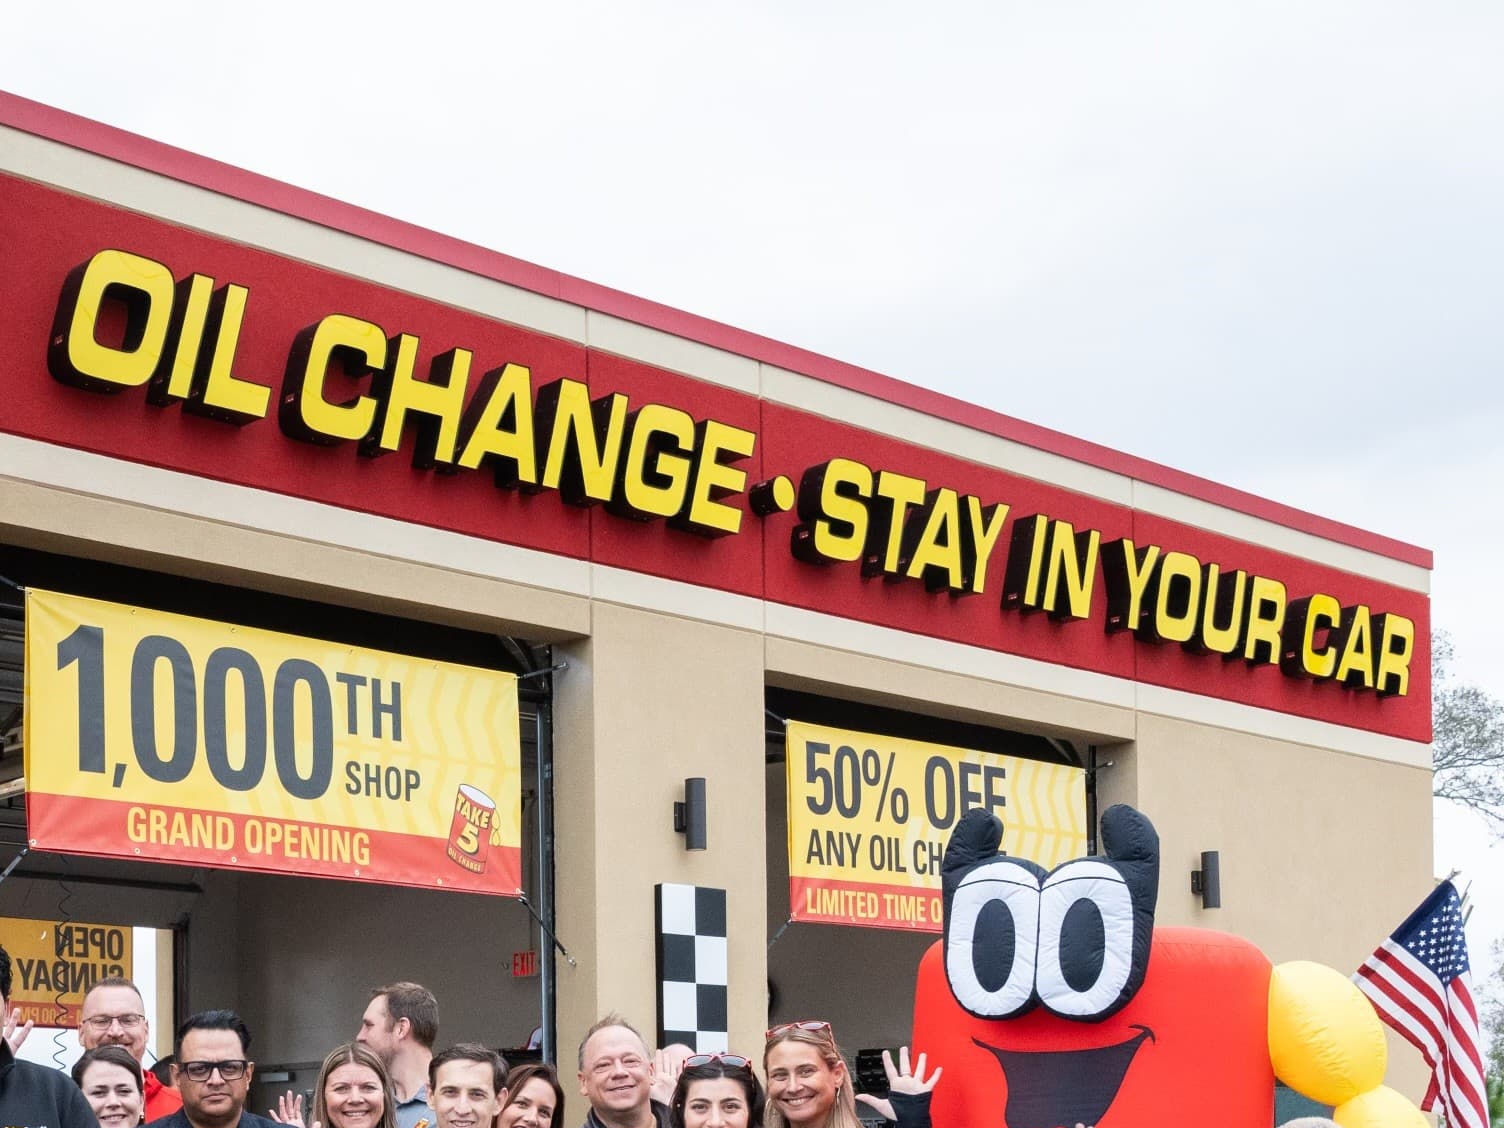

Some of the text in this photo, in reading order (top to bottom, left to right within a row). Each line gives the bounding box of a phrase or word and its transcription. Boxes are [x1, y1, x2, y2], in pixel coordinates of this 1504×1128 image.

[67, 250, 1415, 696] OIL CHANGE STAY IN YOUR CAR
[345, 761, 421, 802] SHOP
[806, 741, 1006, 830] 50% OFF
[456, 792, 491, 829] TAKE
[127, 807, 370, 866] GRAND OPENING
[456, 822, 479, 854] 5
[806, 829, 862, 868] ANY
[870, 835, 906, 873] OIL
[806, 887, 879, 919] LIMITED
[883, 893, 926, 923] TIME
[513, 952, 536, 976] EXIT
